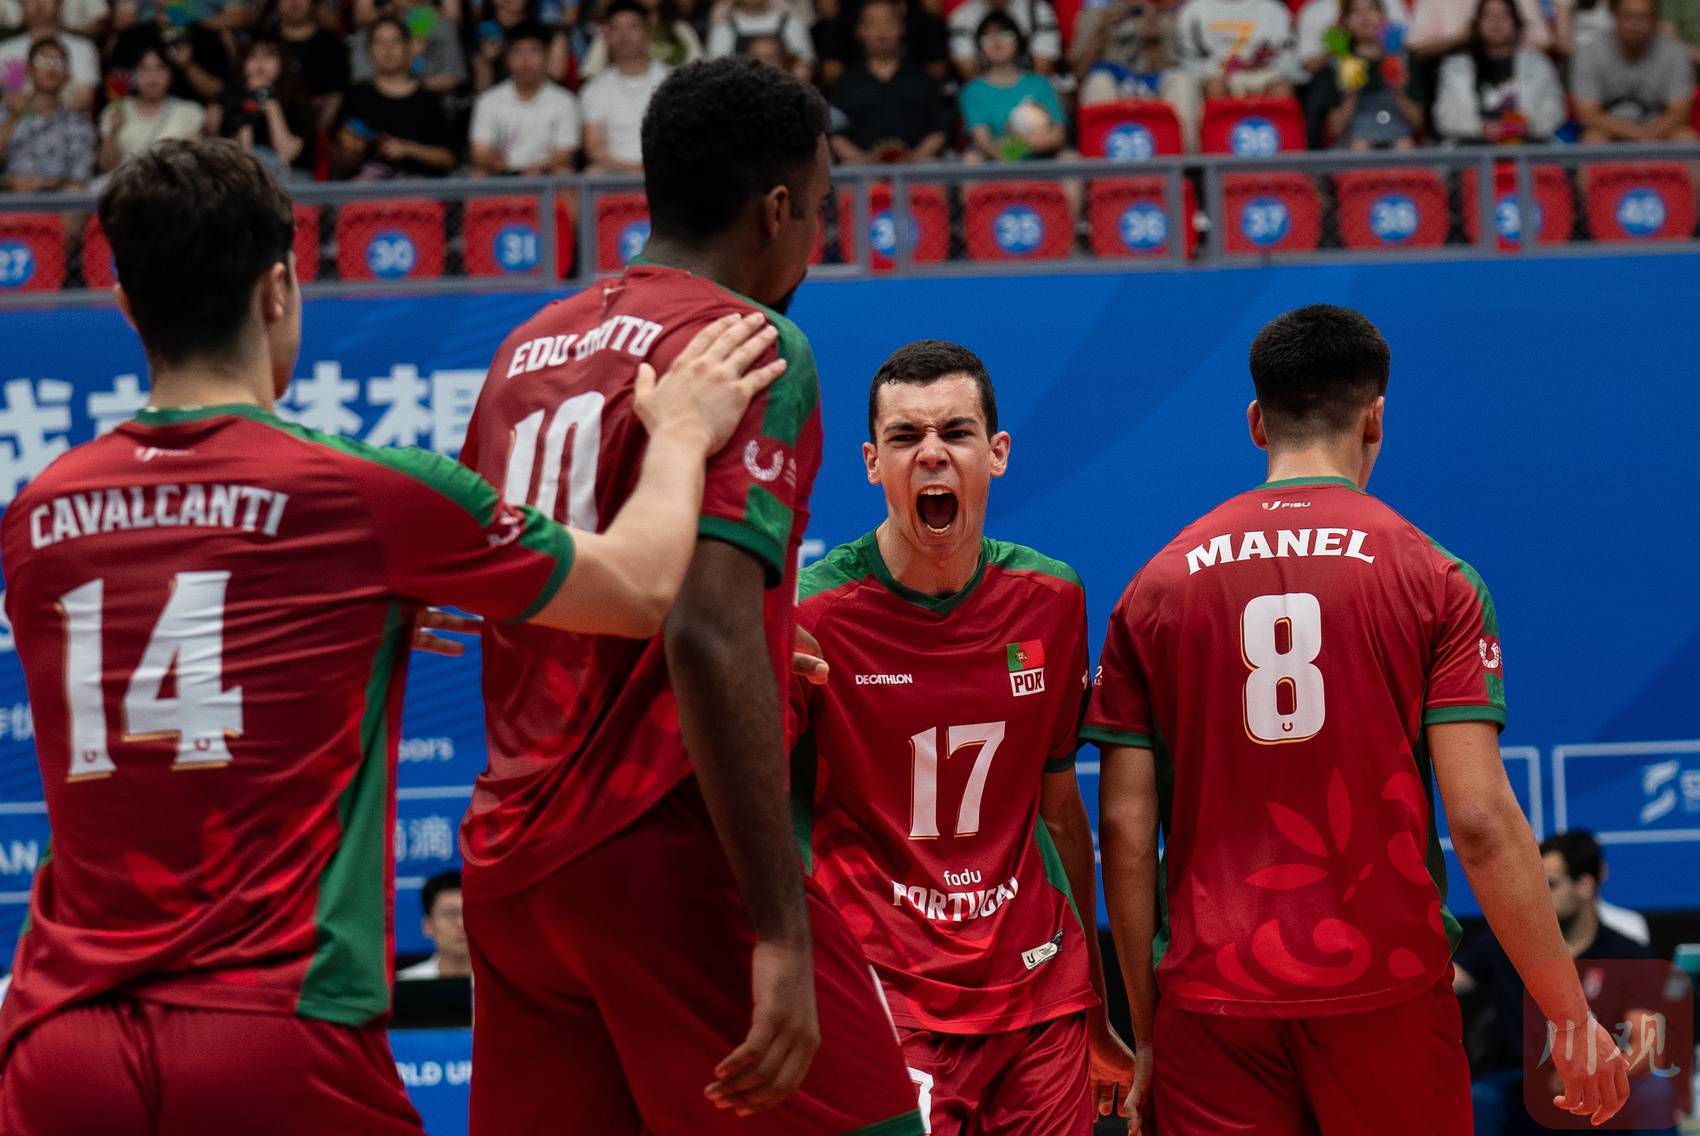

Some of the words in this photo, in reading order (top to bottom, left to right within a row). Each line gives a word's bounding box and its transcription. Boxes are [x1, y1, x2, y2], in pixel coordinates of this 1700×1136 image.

[999, 213, 1041, 247] 35
[1246, 204, 1286, 238] 37
[370, 239, 414, 271] 30
[504, 232, 538, 266] 31
[507, 334, 578, 379] EDU
[503, 391, 606, 532] 10
[30, 484, 289, 549] CAVALCANTI
[1186, 528, 1375, 575] MANEL
[55, 570, 243, 782] 14
[855, 673, 913, 685] DECATHLON
[1240, 592, 1326, 745] 8
[908, 721, 1006, 840] 17
[944, 869, 982, 886] fadu
